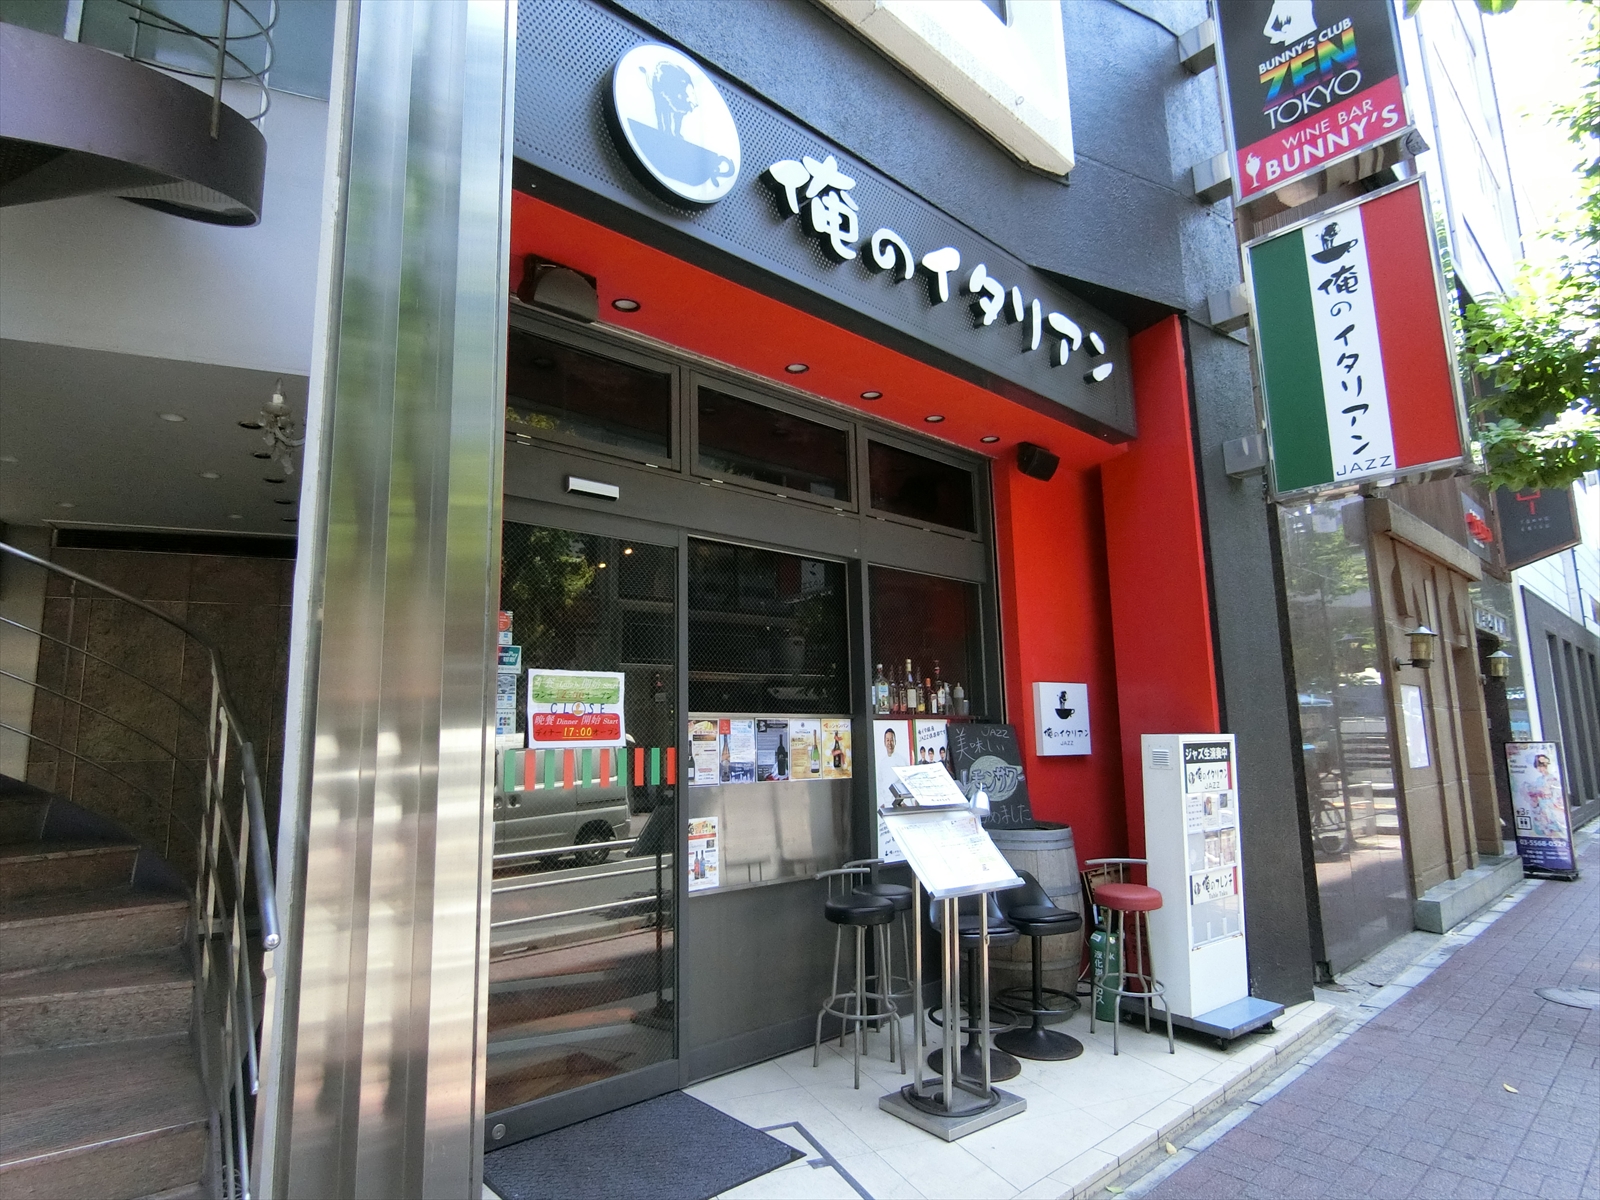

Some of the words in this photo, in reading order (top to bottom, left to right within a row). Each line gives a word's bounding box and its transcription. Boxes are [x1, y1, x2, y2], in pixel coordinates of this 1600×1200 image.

[1258, 36, 1316, 75] BUNNY'S
[1318, 17, 1352, 43] CLUB
[1260, 27, 1360, 112] ZEN
[1264, 69, 1362, 130] TOKYO
[1282, 118, 1330, 149] WINE
[1337, 99, 1374, 126] BAR
[1265, 104, 1399, 181] BUNNY'S
[767, 154, 1114, 383] 俺のイタリアン
[1317, 264, 1370, 456] 俺のイタリアン
[1336, 454, 1392, 477] JAZZ
[581, 714, 601, 726] 開始
[563, 727, 593, 737] 17:00
[981, 726, 1010, 739] JAZZ
[1043, 727, 1089, 739] 俺のイタリアン
[955, 726, 1006, 762] 美味しい
[1185, 747, 1228, 761] ジャズ生演奏中
[1195, 766, 1228, 782] 俺のイタリアン
[1204, 781, 1221, 790] JAZZ
[982, 804, 1032, 825] めました
[1202, 873, 1233, 894] 俺のフレンチ
